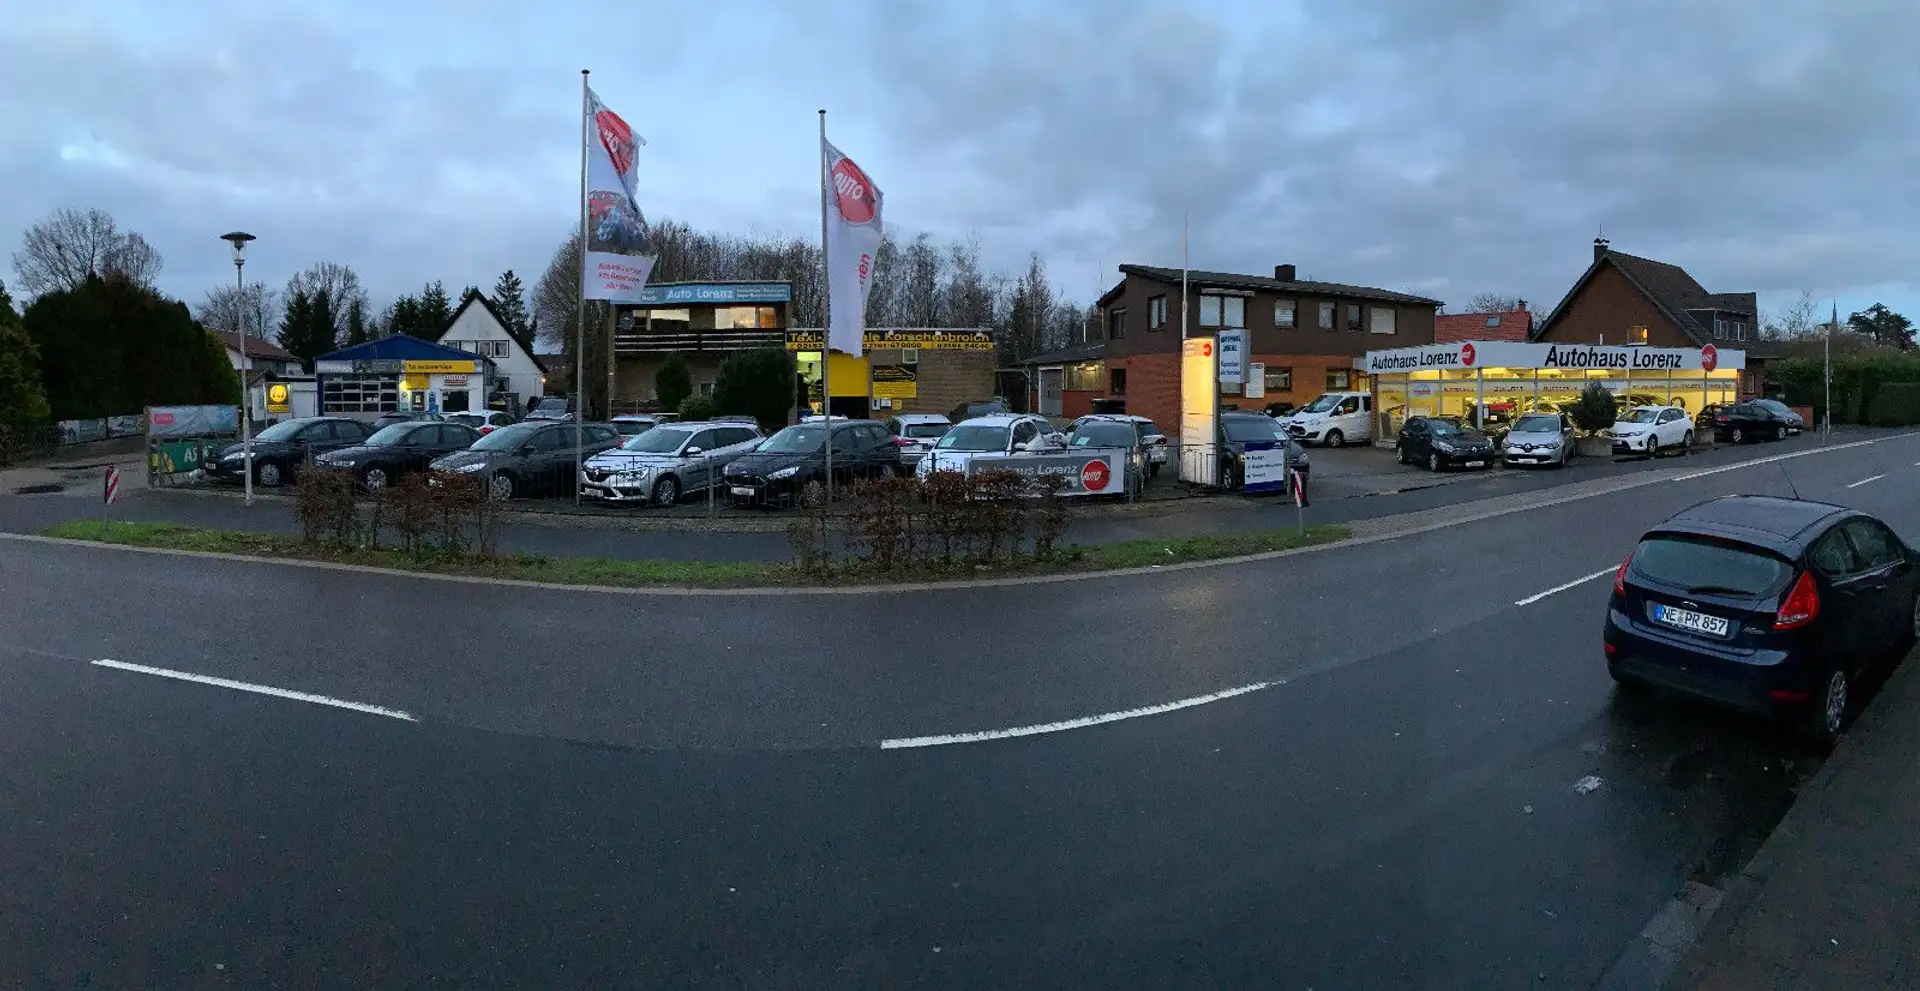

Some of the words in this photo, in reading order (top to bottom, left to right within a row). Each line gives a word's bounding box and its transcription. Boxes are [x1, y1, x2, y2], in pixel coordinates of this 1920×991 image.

[834, 172, 864, 200] AUTO
[667, 286, 692, 299] Auto
[698, 286, 733, 299] Lorenz
[885, 332, 990, 342] Korschenbroich
[1371, 355, 1417, 370] Autohaus
[1419, 351, 1458, 367] Lorenz
[1544, 345, 1628, 368] Autohaus
[1632, 349, 1683, 368] Lorenz
[1037, 464, 1078, 475] Lorenz
[1662, 608, 1677, 622] NE
[1684, 612, 1701, 628] PR
[1701, 616, 1727, 634] 857
